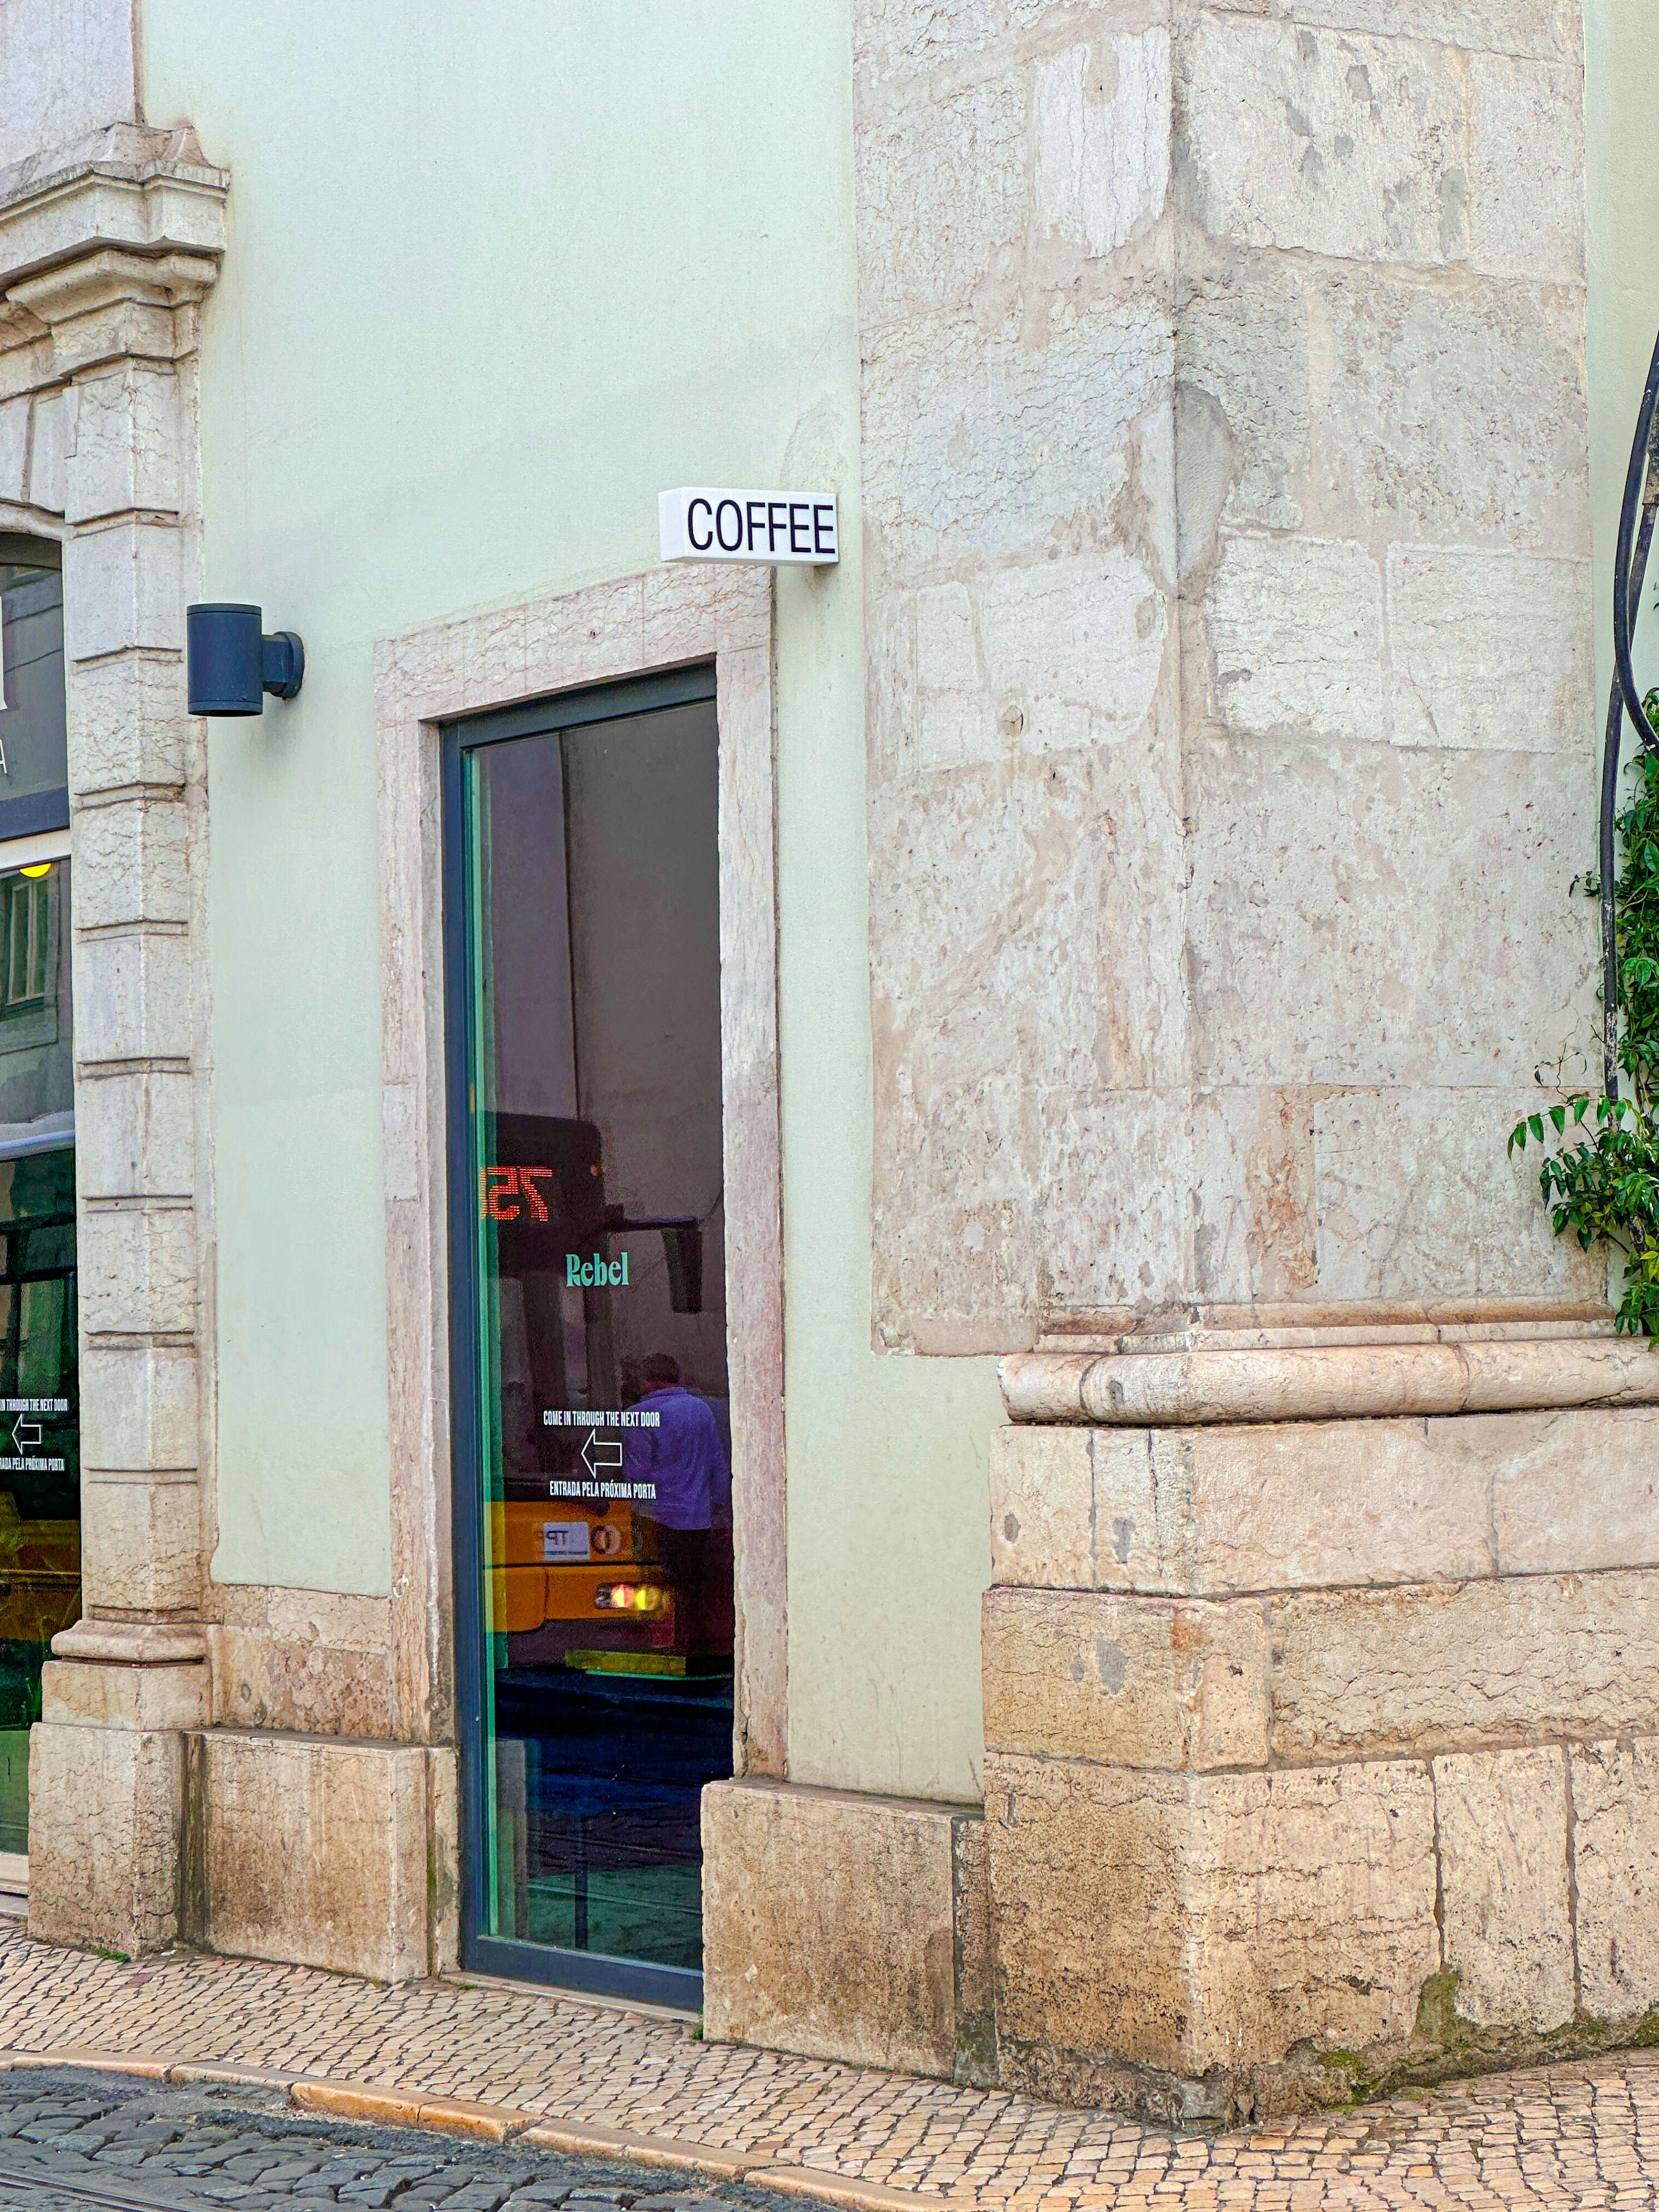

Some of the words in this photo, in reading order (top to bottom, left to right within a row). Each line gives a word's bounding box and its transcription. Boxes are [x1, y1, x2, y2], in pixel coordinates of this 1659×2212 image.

[687, 498, 836, 554] COFFEE
[566, 1252, 629, 1288] Rebel
[6, 1399, 29, 1411] THROUGH
[30, 1399, 40, 1411] THE
[40, 1399, 53, 1411] NEXT
[54, 1399, 67, 1411] DOOR
[543, 1410, 562, 1426] COME
[563, 1411, 571, 1426] IN
[572, 1411, 604, 1426] THROUGH
[606, 1412, 619, 1426] THE
[621, 1412, 639, 1427] NEXT
[640, 1412, 660, 1427] DOOR
[12, 1458, 25, 1470] PELA
[25, 1455, 47, 1471] PRÓXIMA
[48, 1458, 65, 1471] PORTA
[550, 1481, 580, 1497] ENTRADA
[582, 1482, 599, 1497] PELA
[600, 1480, 631, 1498] PRÓXIMA
[633, 1483, 656, 1499] PORTA
